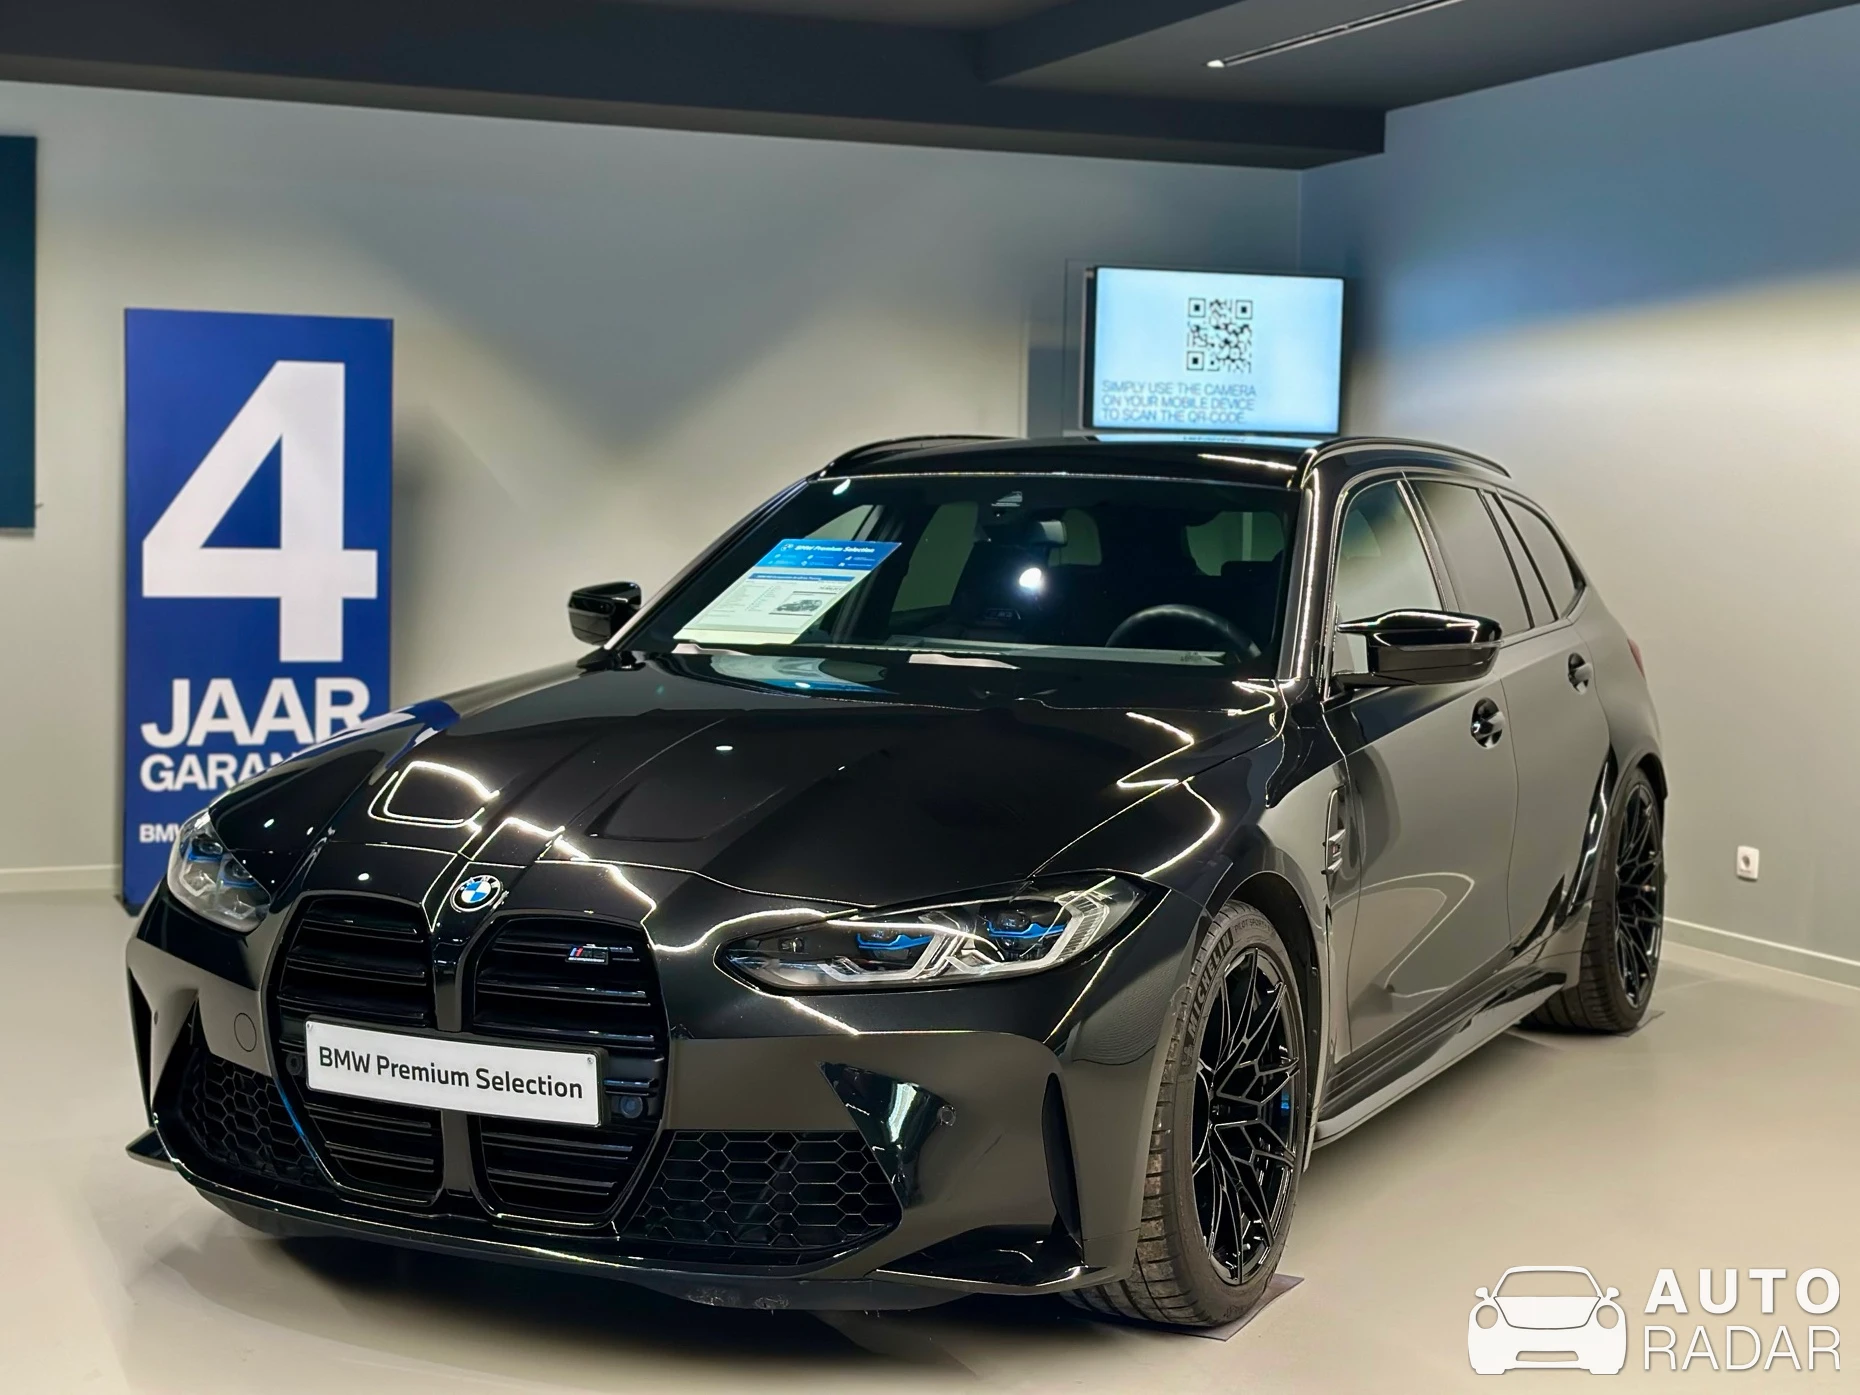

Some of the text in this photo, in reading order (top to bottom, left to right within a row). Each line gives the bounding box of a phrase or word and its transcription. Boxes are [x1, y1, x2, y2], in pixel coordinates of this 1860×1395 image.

[1101, 380, 1257, 397] SIMPLY USE THE CAMERA
[1101, 394, 1255, 411] ON YOUR MOBILE DEVICE
[1101, 407, 1120, 421] TO
[1122, 408, 1157, 422] SCAN
[1160, 409, 1185, 423] THE
[141, 359, 378, 662] 4
[813, 544, 843, 552] Premium
[843, 545, 875, 553] Selection
[140, 676, 370, 750] JAAR
[140, 752, 299, 792] GARA
[1187, 928, 1234, 1038] MICHELIN
[319, 1045, 583, 1099] BMW Premium Selection
